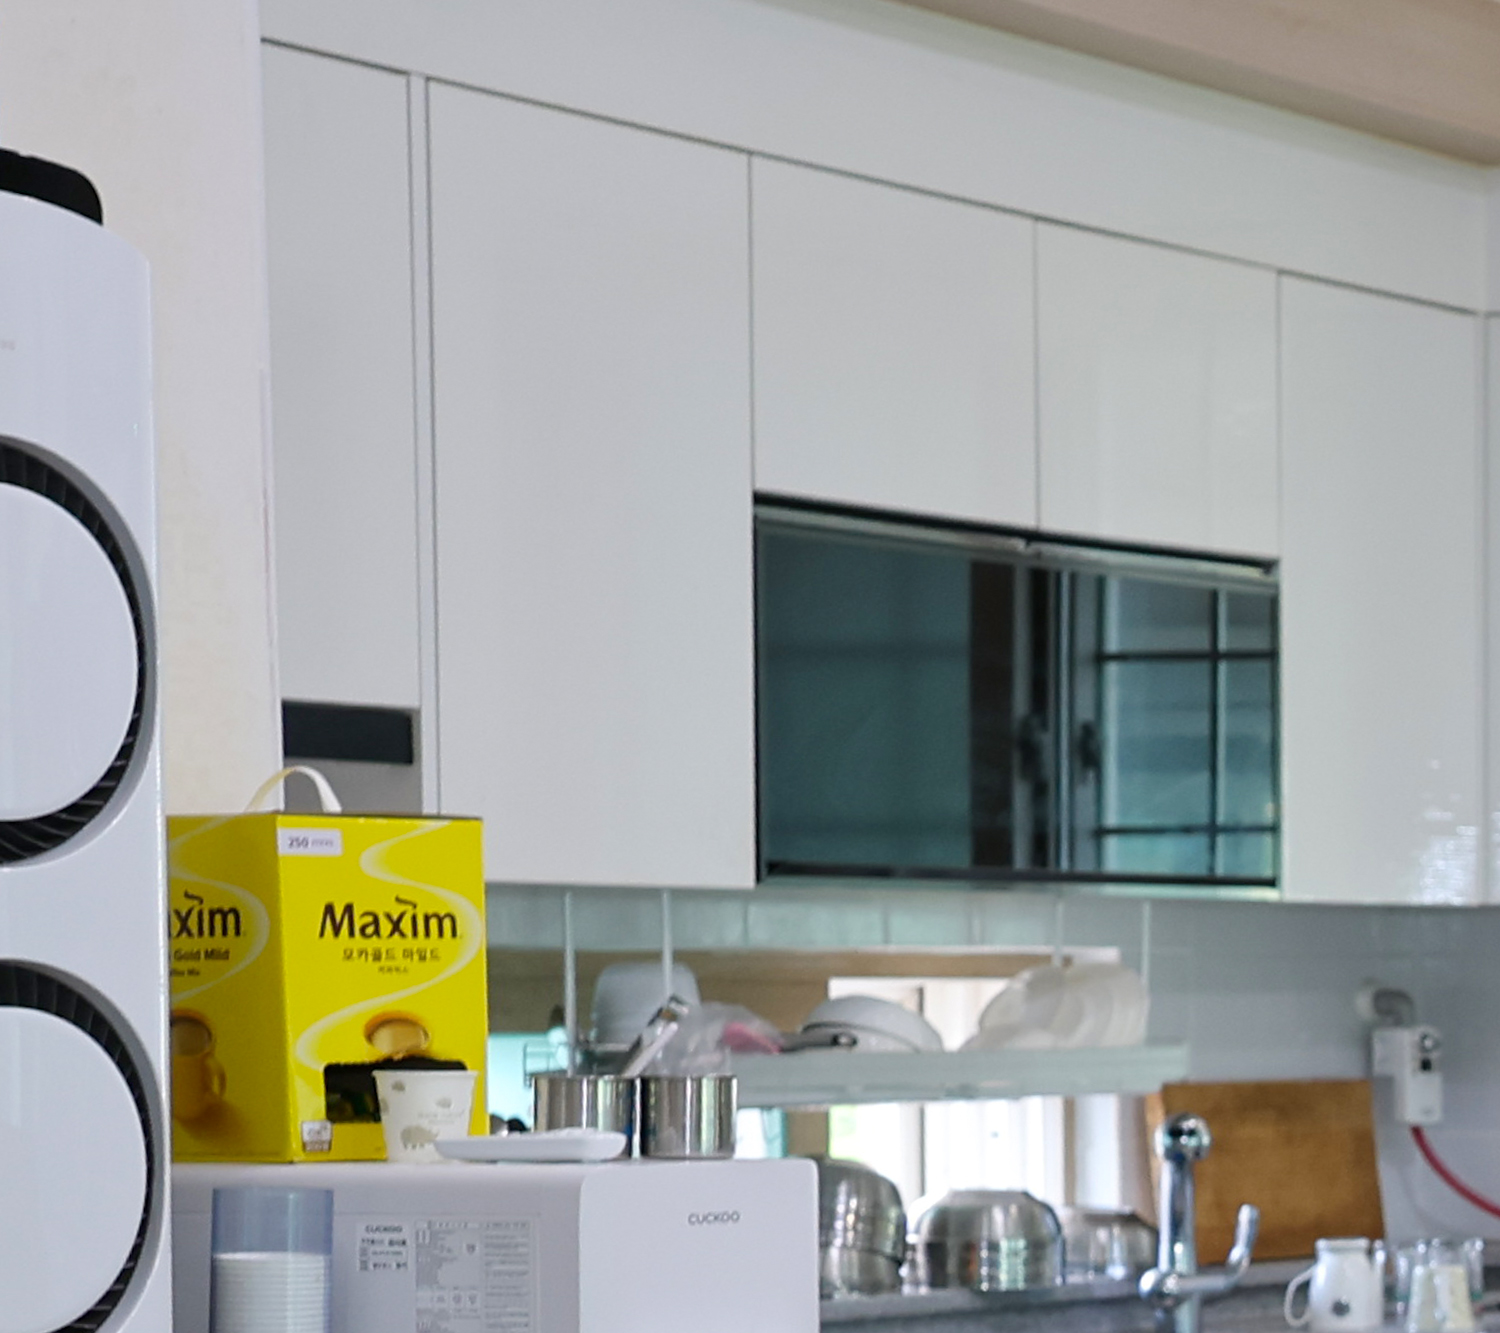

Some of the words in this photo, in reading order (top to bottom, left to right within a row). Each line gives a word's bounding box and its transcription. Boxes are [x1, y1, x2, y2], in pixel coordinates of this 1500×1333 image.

[168, 890, 241, 938] xim
[318, 894, 457, 940] Maxim
[343, 947, 396, 962] 모카골드
[402, 947, 440, 962] 마일드
[688, 1210, 740, 1226] CUCKOO
